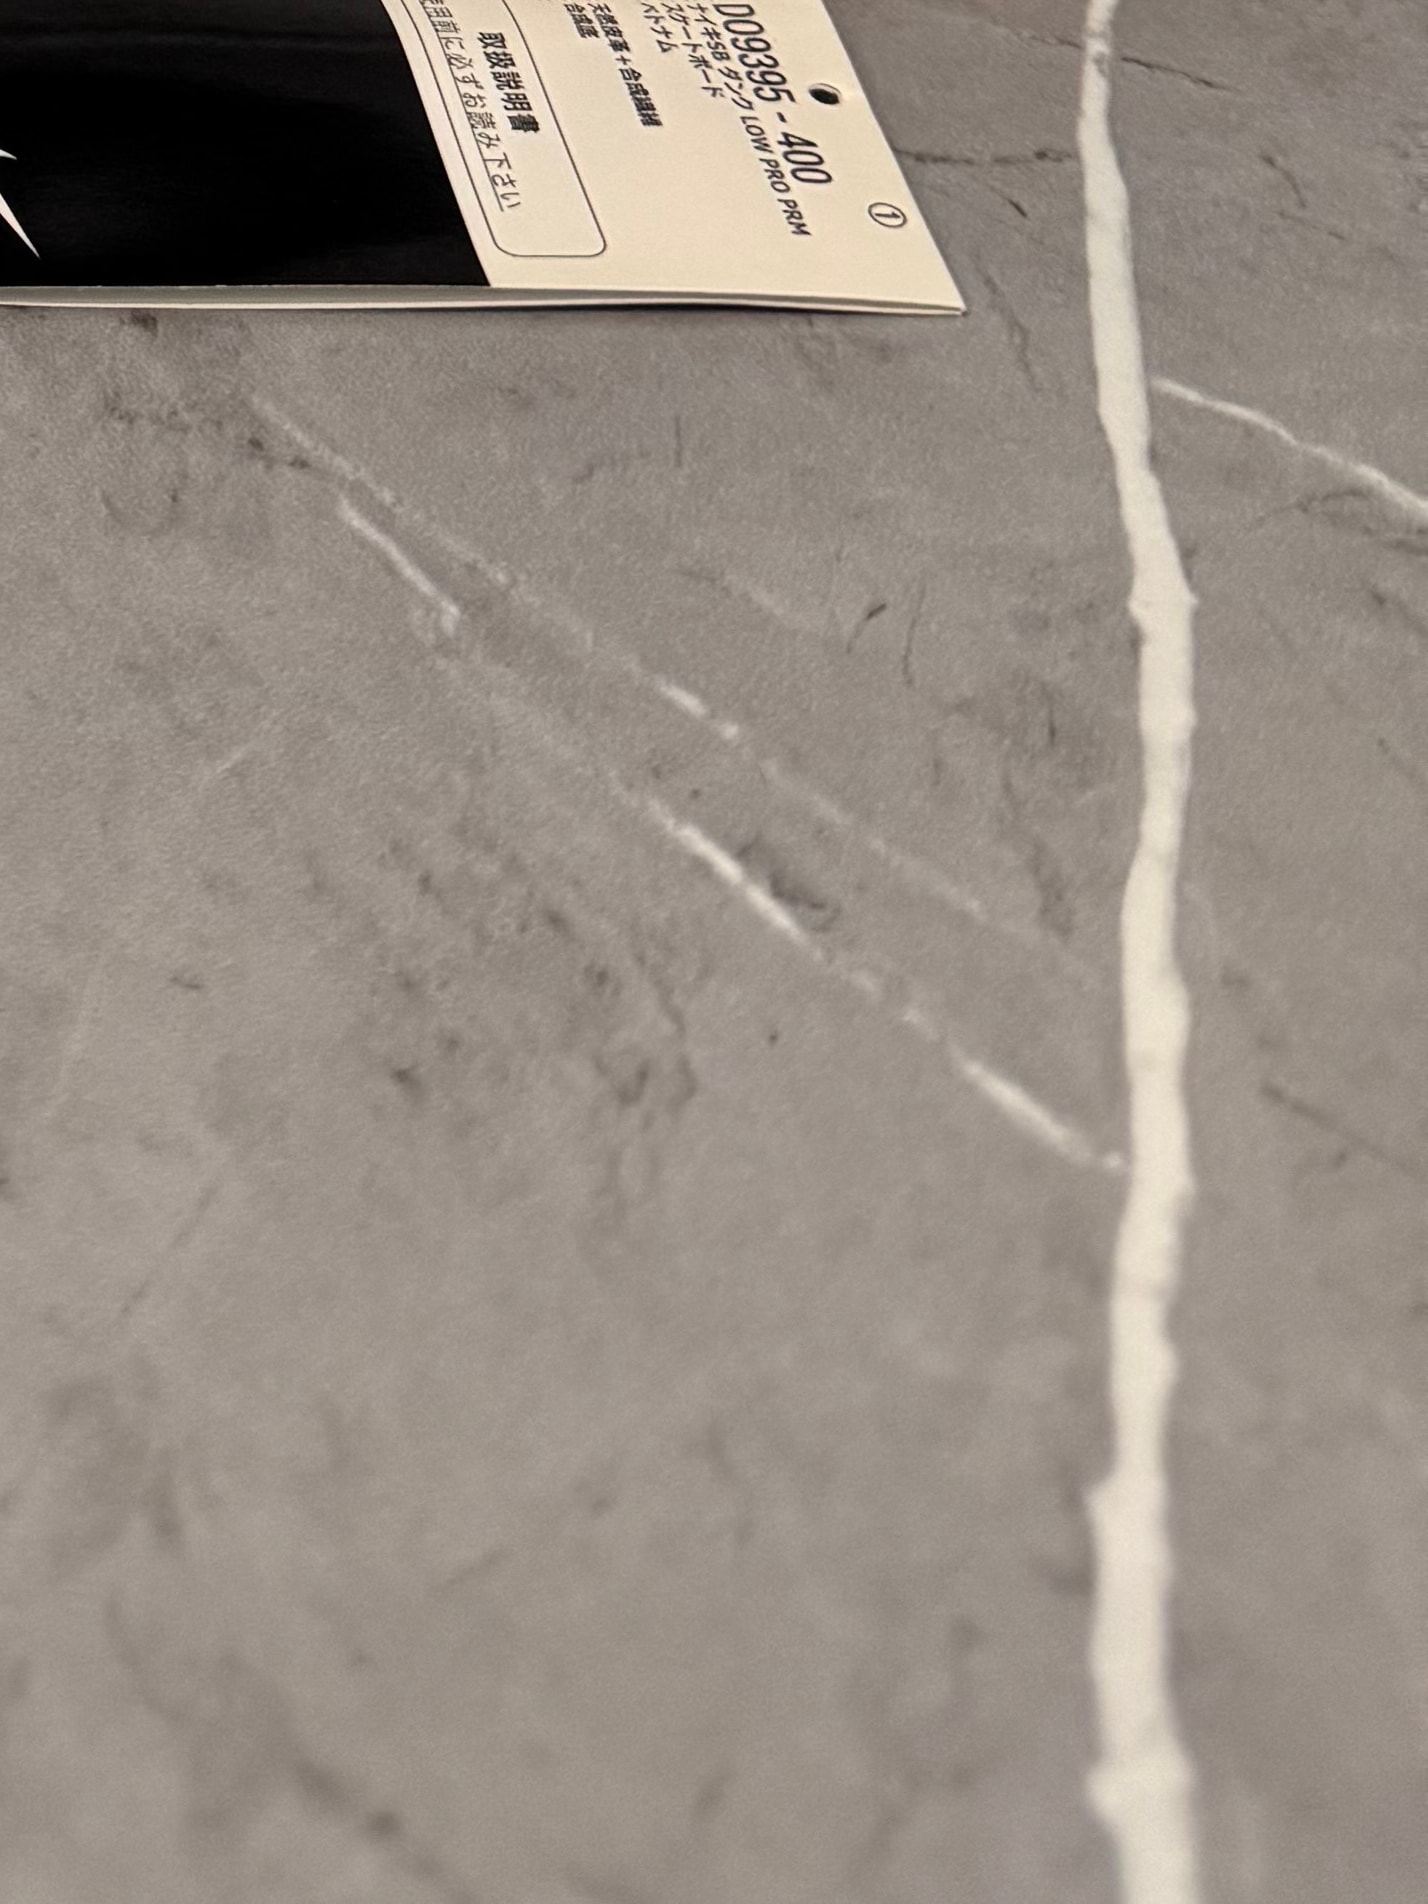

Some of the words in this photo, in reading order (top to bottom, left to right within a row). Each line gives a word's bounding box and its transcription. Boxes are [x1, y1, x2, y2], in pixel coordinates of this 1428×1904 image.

[639, 1, 679, 54] ベトナム
[660, 2, 725, 98] スケートボード
[477, 31, 540, 133] 取扱説明書
[716, 66, 755, 111] ダンク
[738, 114, 775, 154] LOW
[757, 156, 791, 194] PRO
[776, 197, 812, 236] PRM
[776, 130, 833, 185] 400
